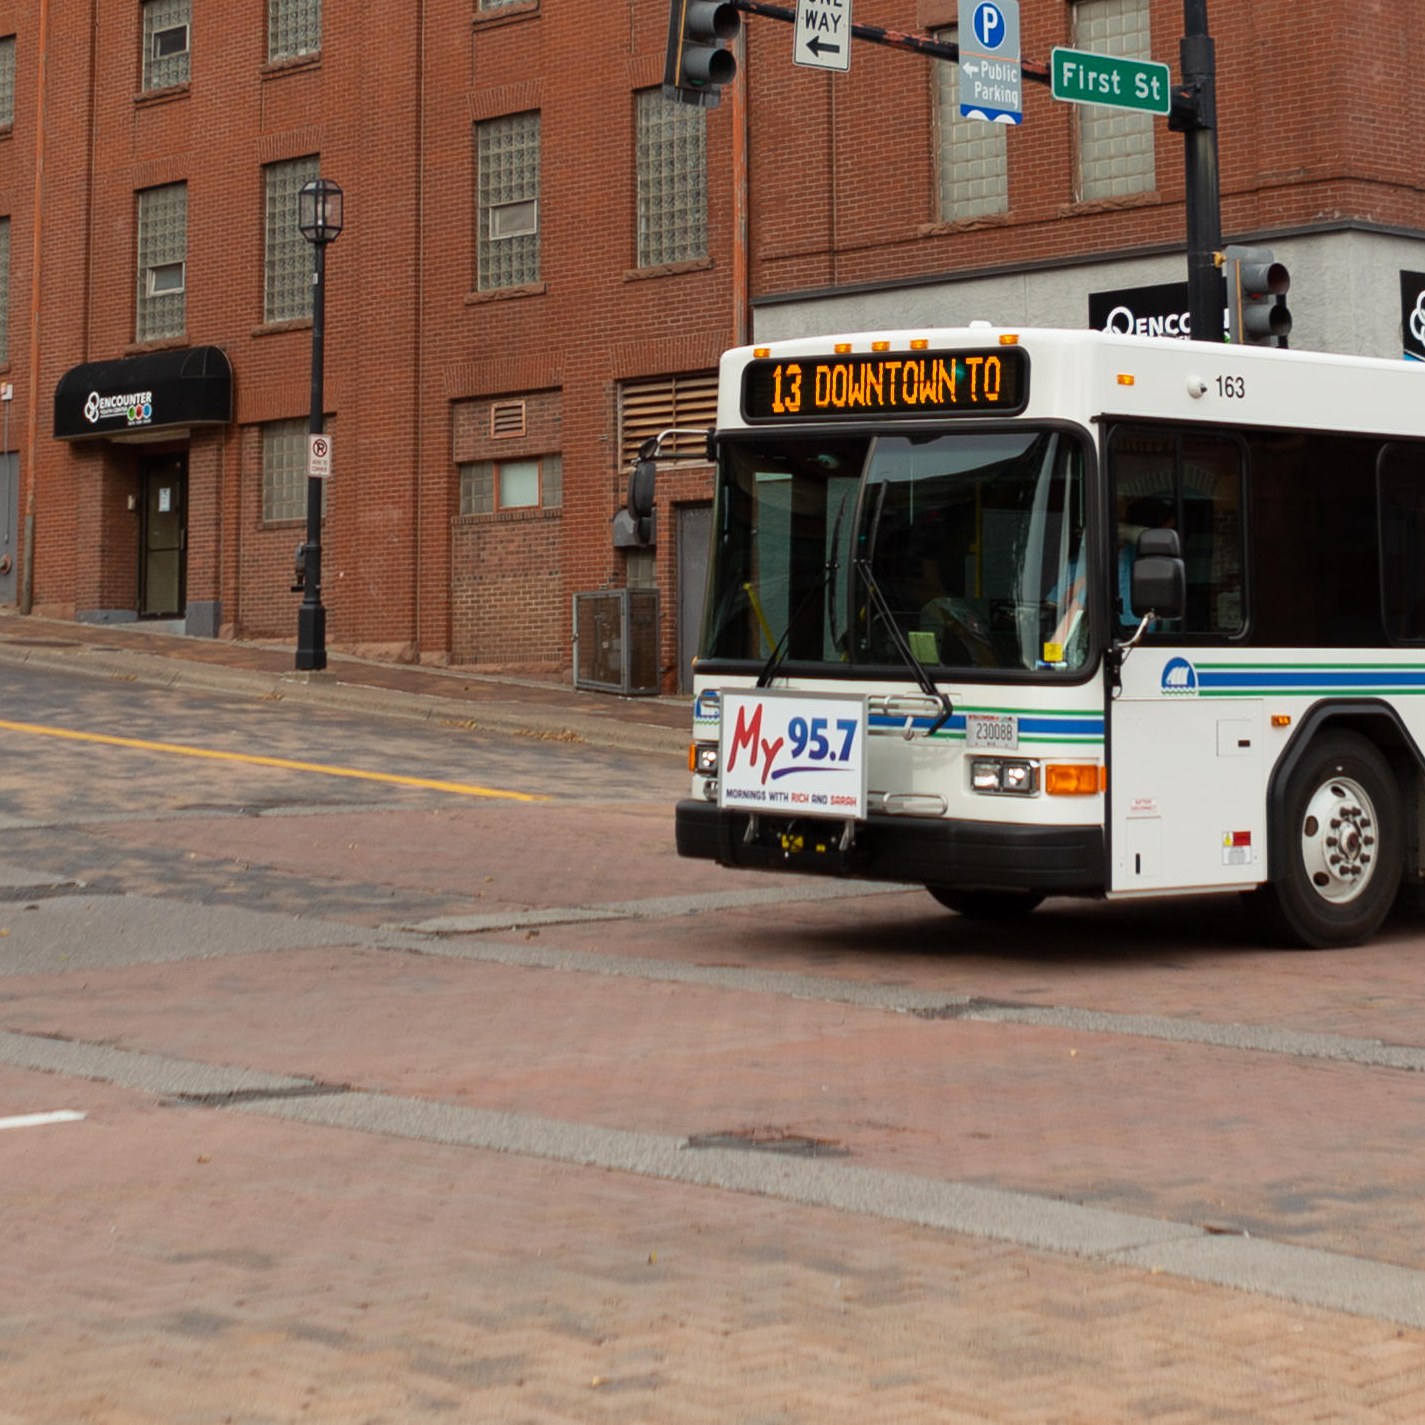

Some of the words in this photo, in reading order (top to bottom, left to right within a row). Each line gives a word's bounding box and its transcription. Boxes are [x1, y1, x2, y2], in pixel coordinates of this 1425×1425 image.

[805, 9, 842, 33] WAY
[982, 6, 998, 43] P
[981, 60, 1018, 82] Public
[1063, 62, 1121, 94] First
[1135, 72, 1160, 100] St
[974, 81, 1018, 110] Parking
[772, 364, 802, 413] 13
[815, 358, 957, 408] DOWNTOWN
[965, 356, 1001, 402] TO
[1215, 375, 1245, 399] 163
[99, 391, 152, 408] ENCOUNTER
[727, 703, 784, 786] My
[788, 716, 858, 761] 95.7
[726, 789, 766, 801] MORNINGS
[769, 791, 789, 802] WITH
[791, 792, 809, 804] RICH
[811, 794, 828, 805] AND
[830, 795, 857, 807] SARAH
